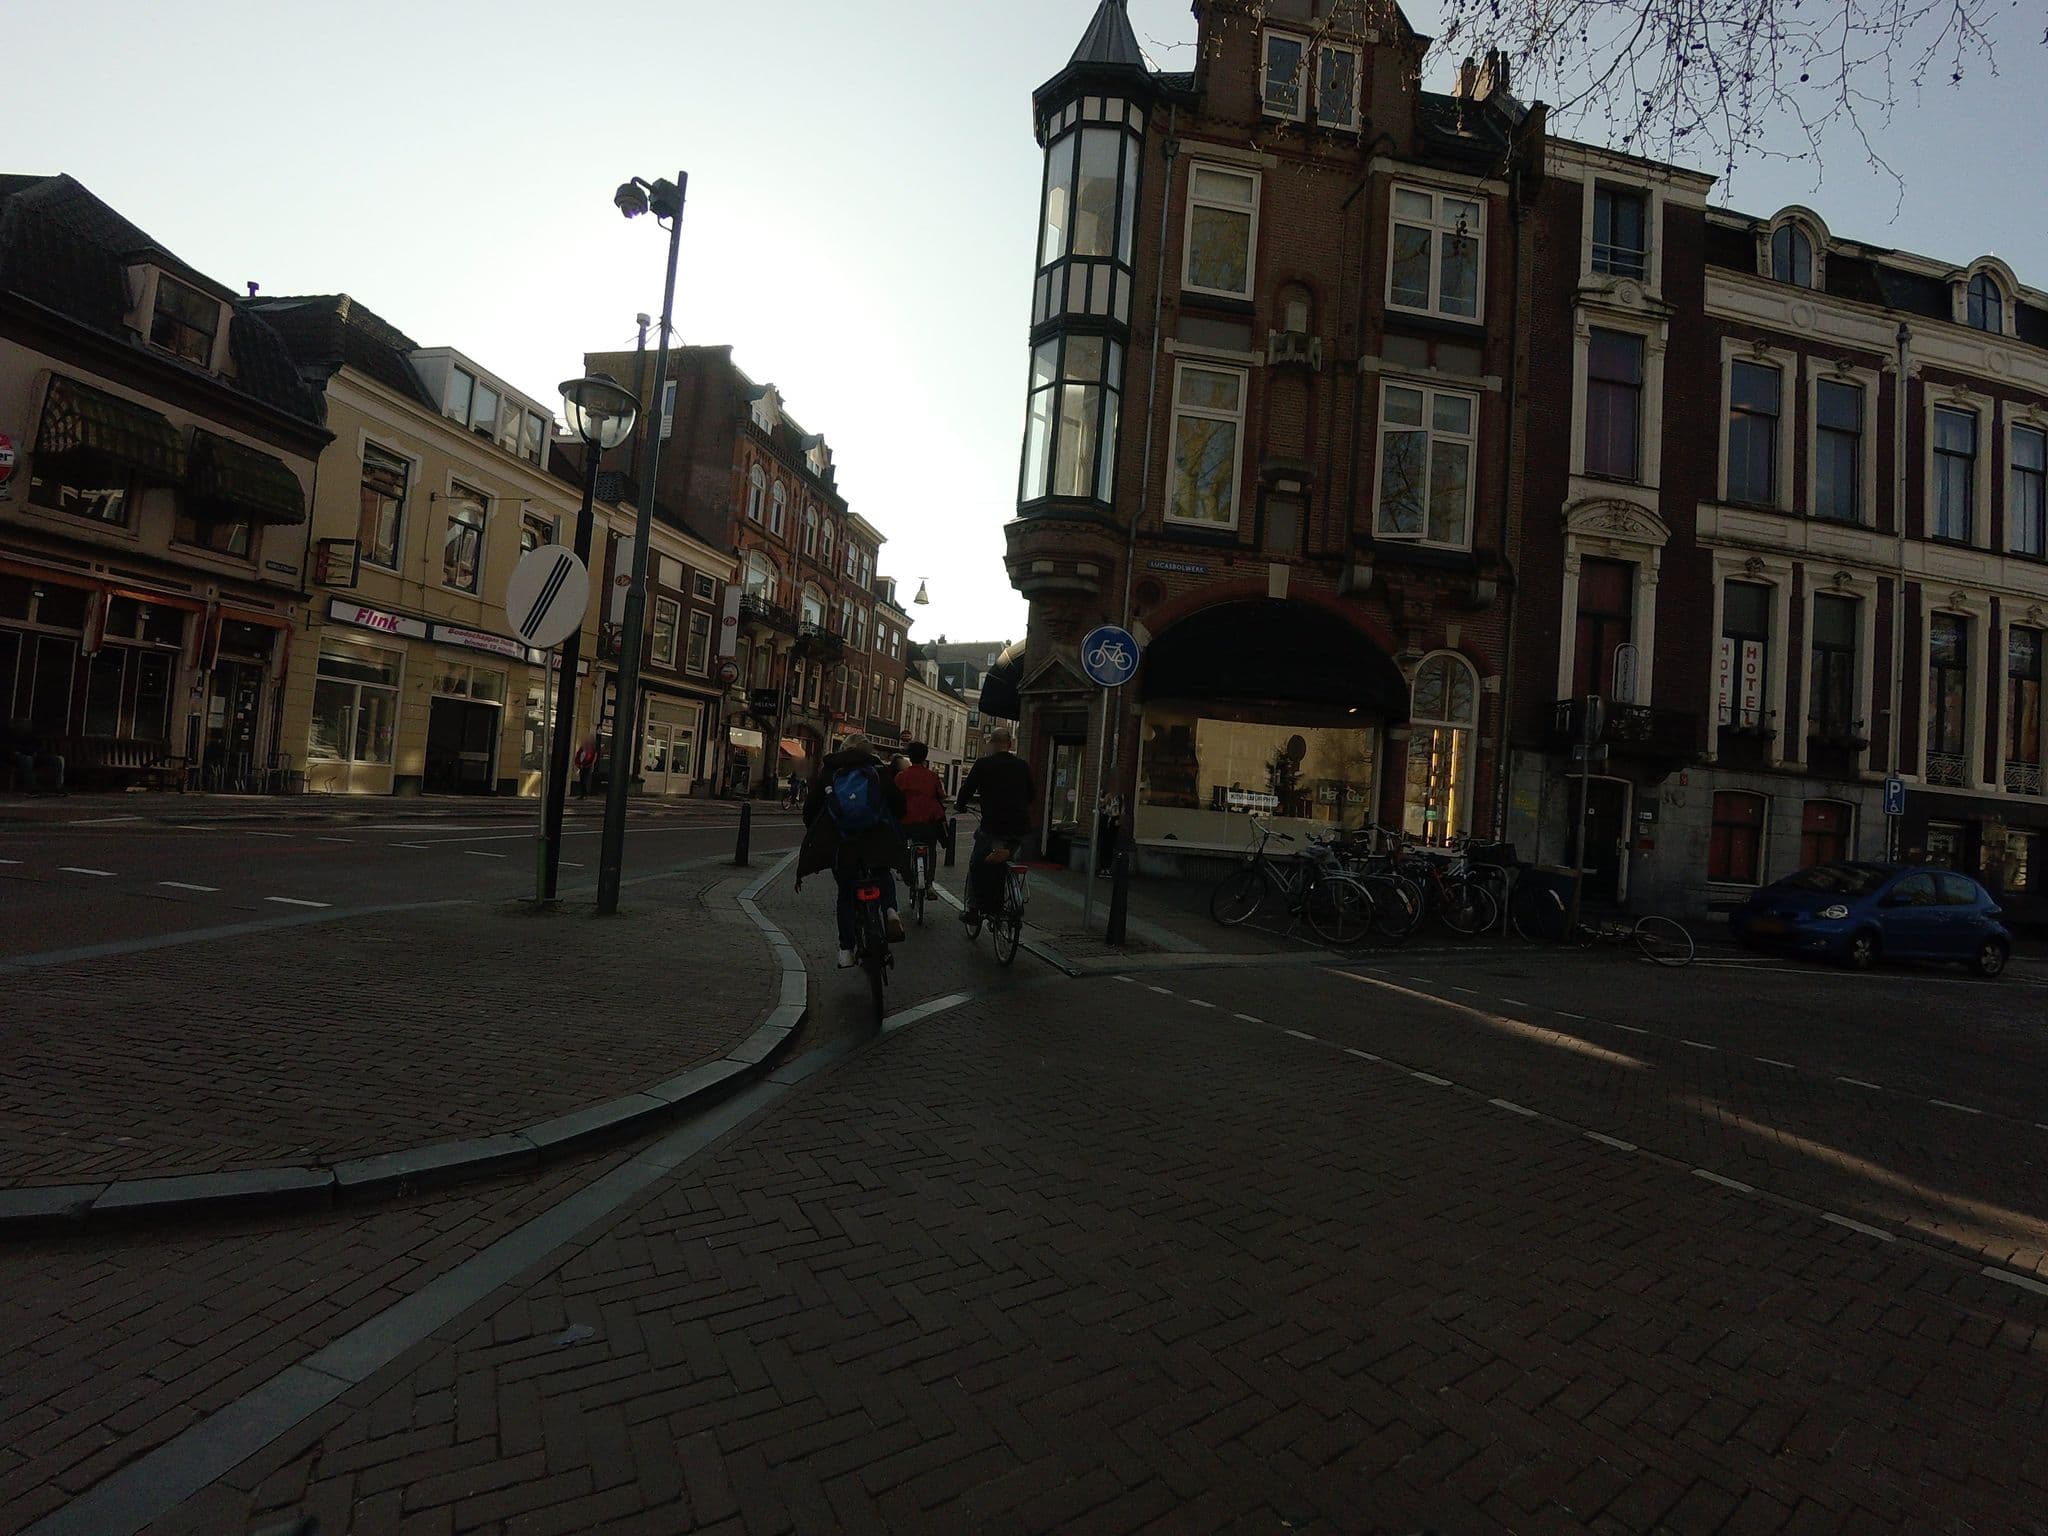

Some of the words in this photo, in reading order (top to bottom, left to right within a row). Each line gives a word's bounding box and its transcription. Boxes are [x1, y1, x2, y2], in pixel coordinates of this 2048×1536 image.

[1150, 561, 1205, 573] LUCASBOLWERK
[355, 607, 399, 631] Flink
[1744, 646, 1758, 726] HOTEL
[1889, 782, 1901, 800] P
